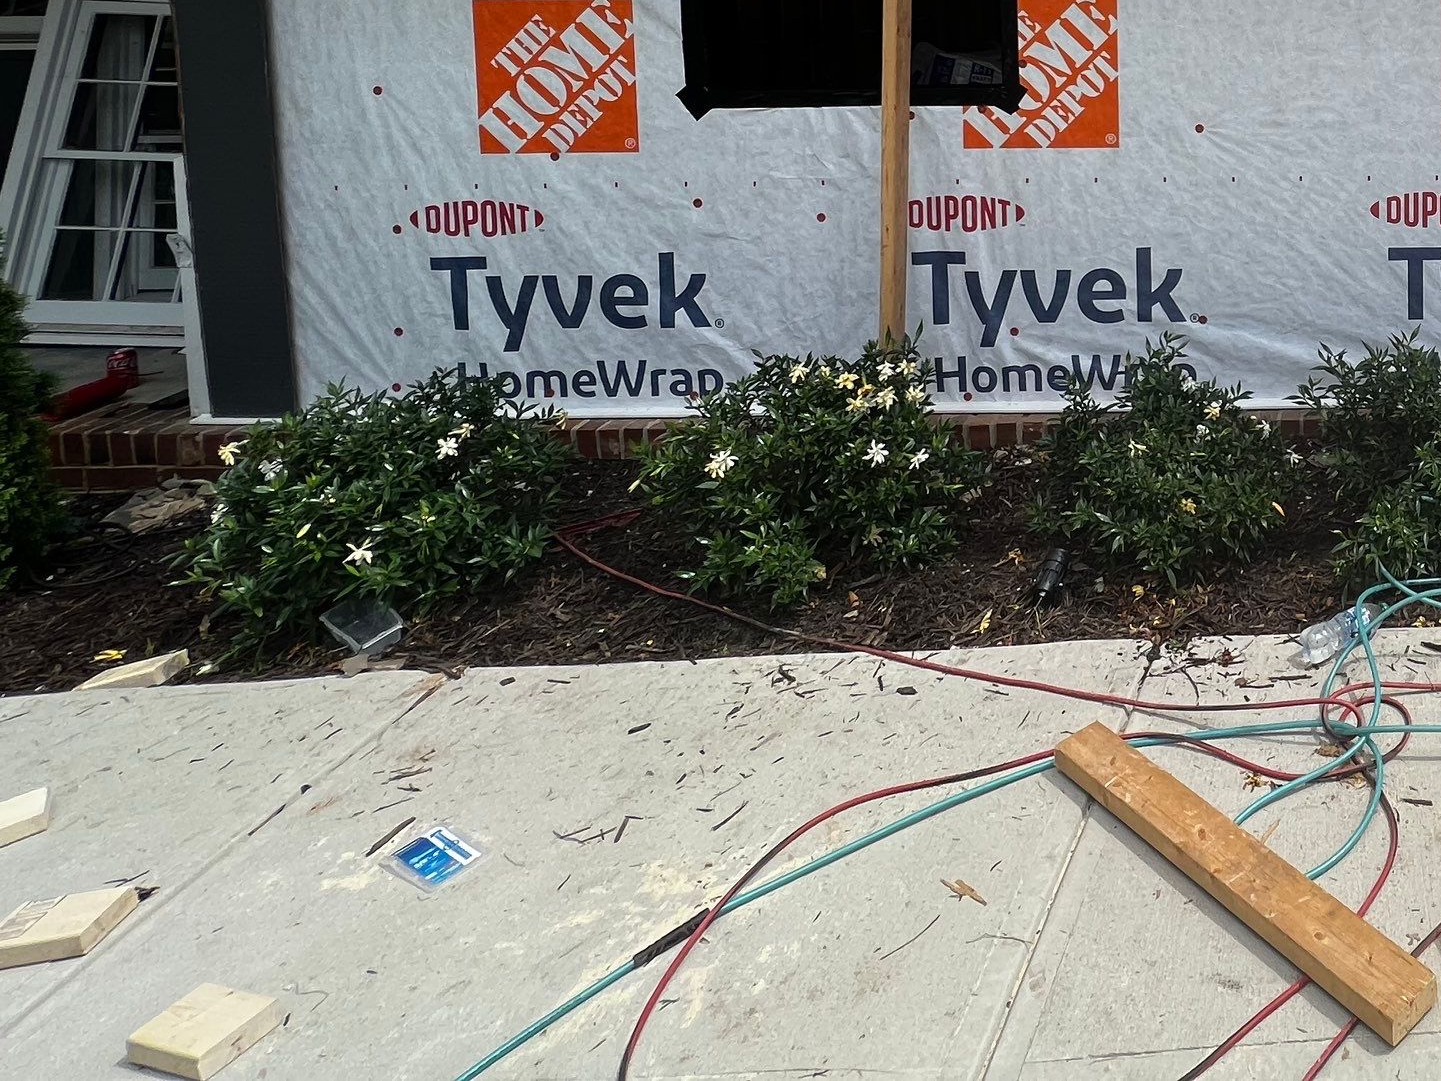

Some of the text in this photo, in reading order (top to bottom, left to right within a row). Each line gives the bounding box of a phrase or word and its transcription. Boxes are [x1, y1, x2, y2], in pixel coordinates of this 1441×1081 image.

[490, 14, 556, 78] THE
[541, 54, 637, 155] DEPOT
[1024, 51, 1120, 149] DEPOT
[425, 200, 530, 238] DUPONT
[908, 195, 1011, 233] DUPONT
[429, 251, 712, 352] Tyvek
[911, 247, 1188, 348] Tyvek
